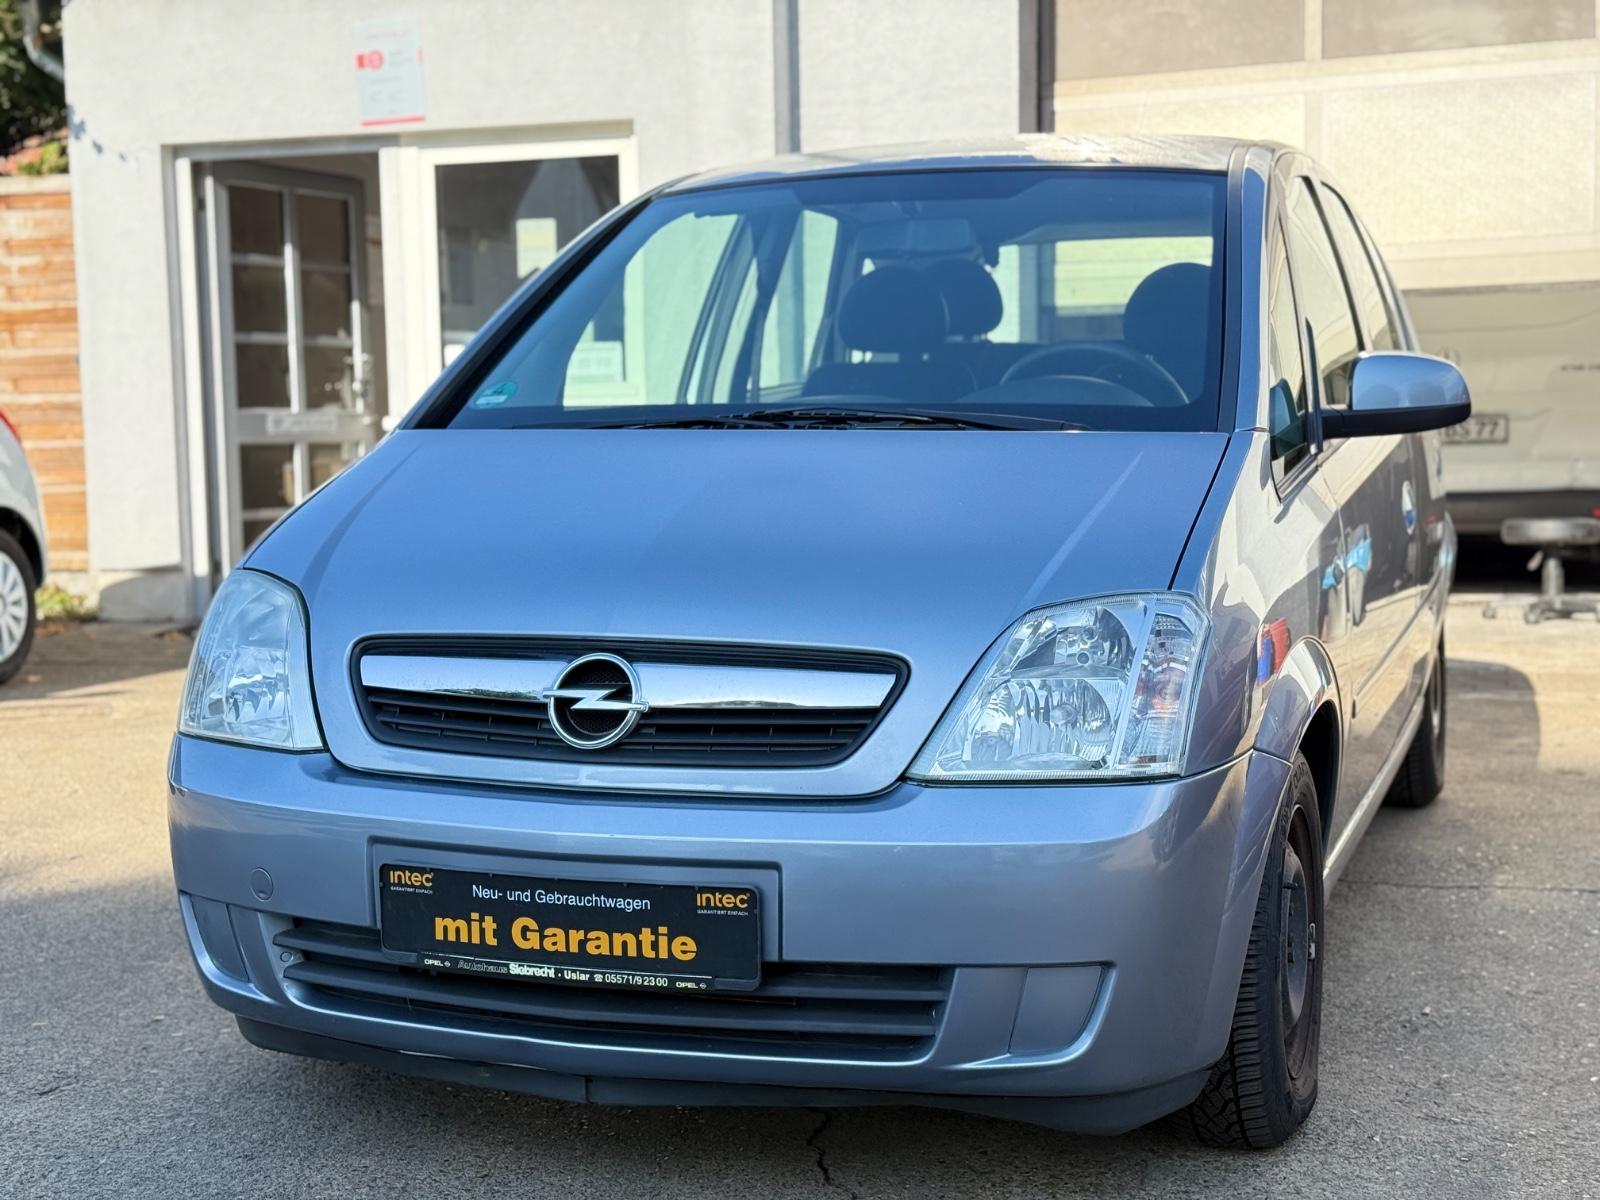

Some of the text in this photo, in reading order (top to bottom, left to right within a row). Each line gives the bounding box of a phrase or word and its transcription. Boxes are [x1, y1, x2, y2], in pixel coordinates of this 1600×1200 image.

[1476, 421, 1499, 437] 77
[389, 870, 433, 887] intec
[472, 884, 651, 912] Neu- und Gebrauchtwagen
[696, 891, 748, 908] intec
[434, 912, 698, 961] mit Garantie
[424, 958, 444, 967] OPEL
[457, 960, 508, 974] Autohaus
[509, 963, 555, 979] Siebrecht
[563, 969, 590, 981] Uslar
[675, 981, 699, 989] OPEL
